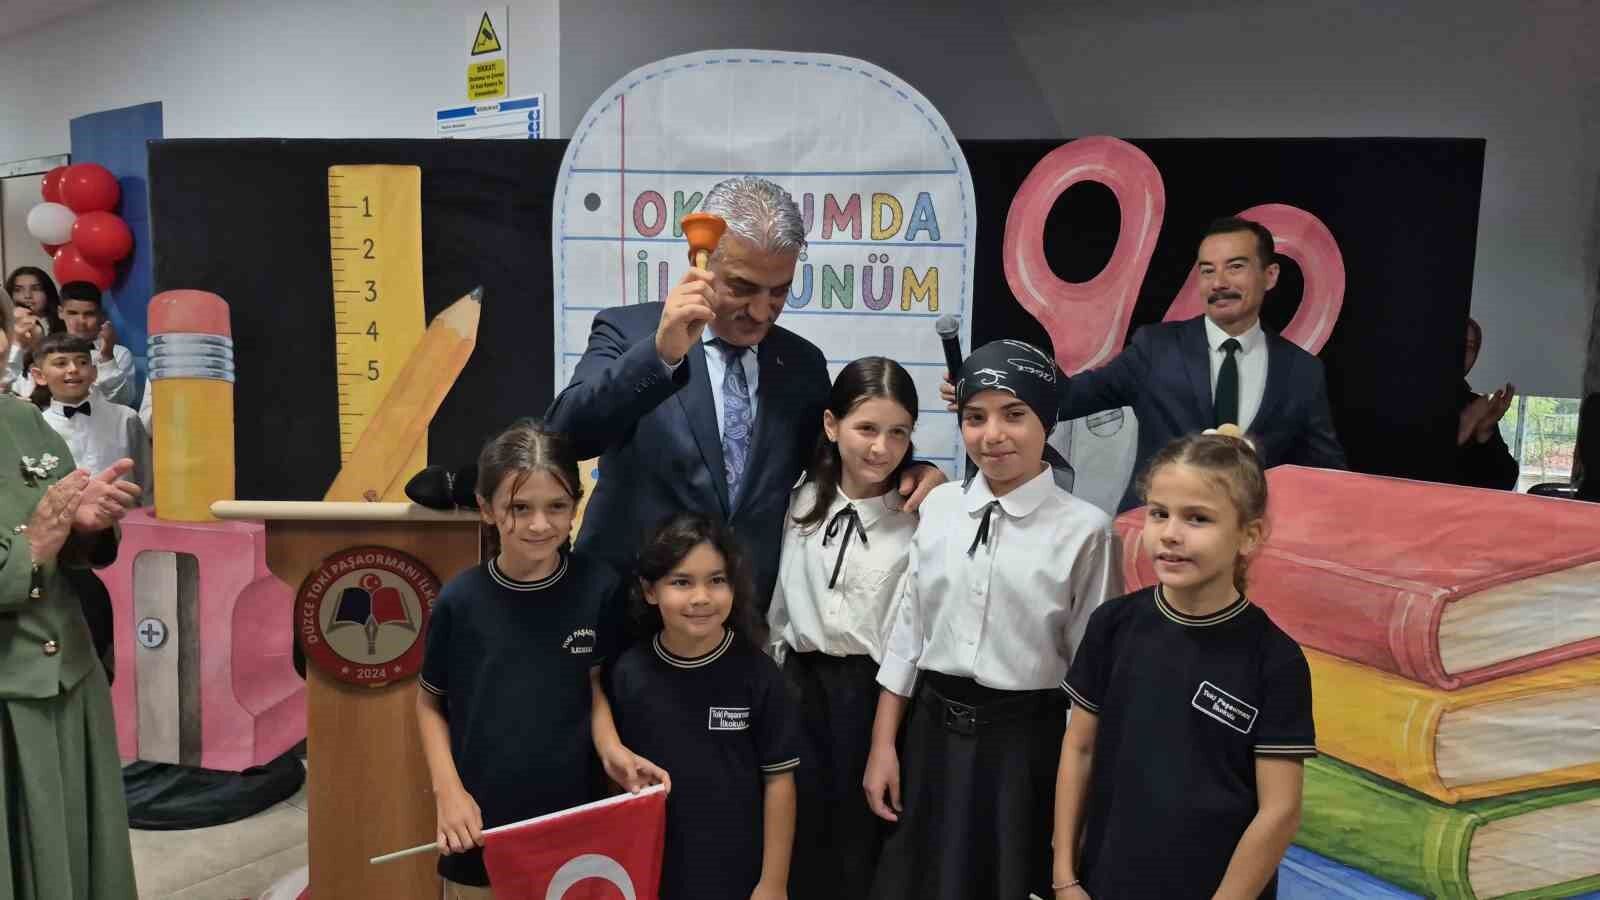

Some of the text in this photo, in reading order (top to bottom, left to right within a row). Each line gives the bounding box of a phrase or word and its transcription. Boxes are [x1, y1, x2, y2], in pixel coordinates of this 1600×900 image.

[361, 196, 373, 217] 1
[633, 190, 941, 242] OKMDA
[363, 238, 376, 259] 2
[364, 280, 377, 302] 3
[786, 252, 939, 312] ÜNÜM
[366, 321, 379, 342] 4
[367, 360, 380, 381] 5
[356, 667, 386, 679] 2024
